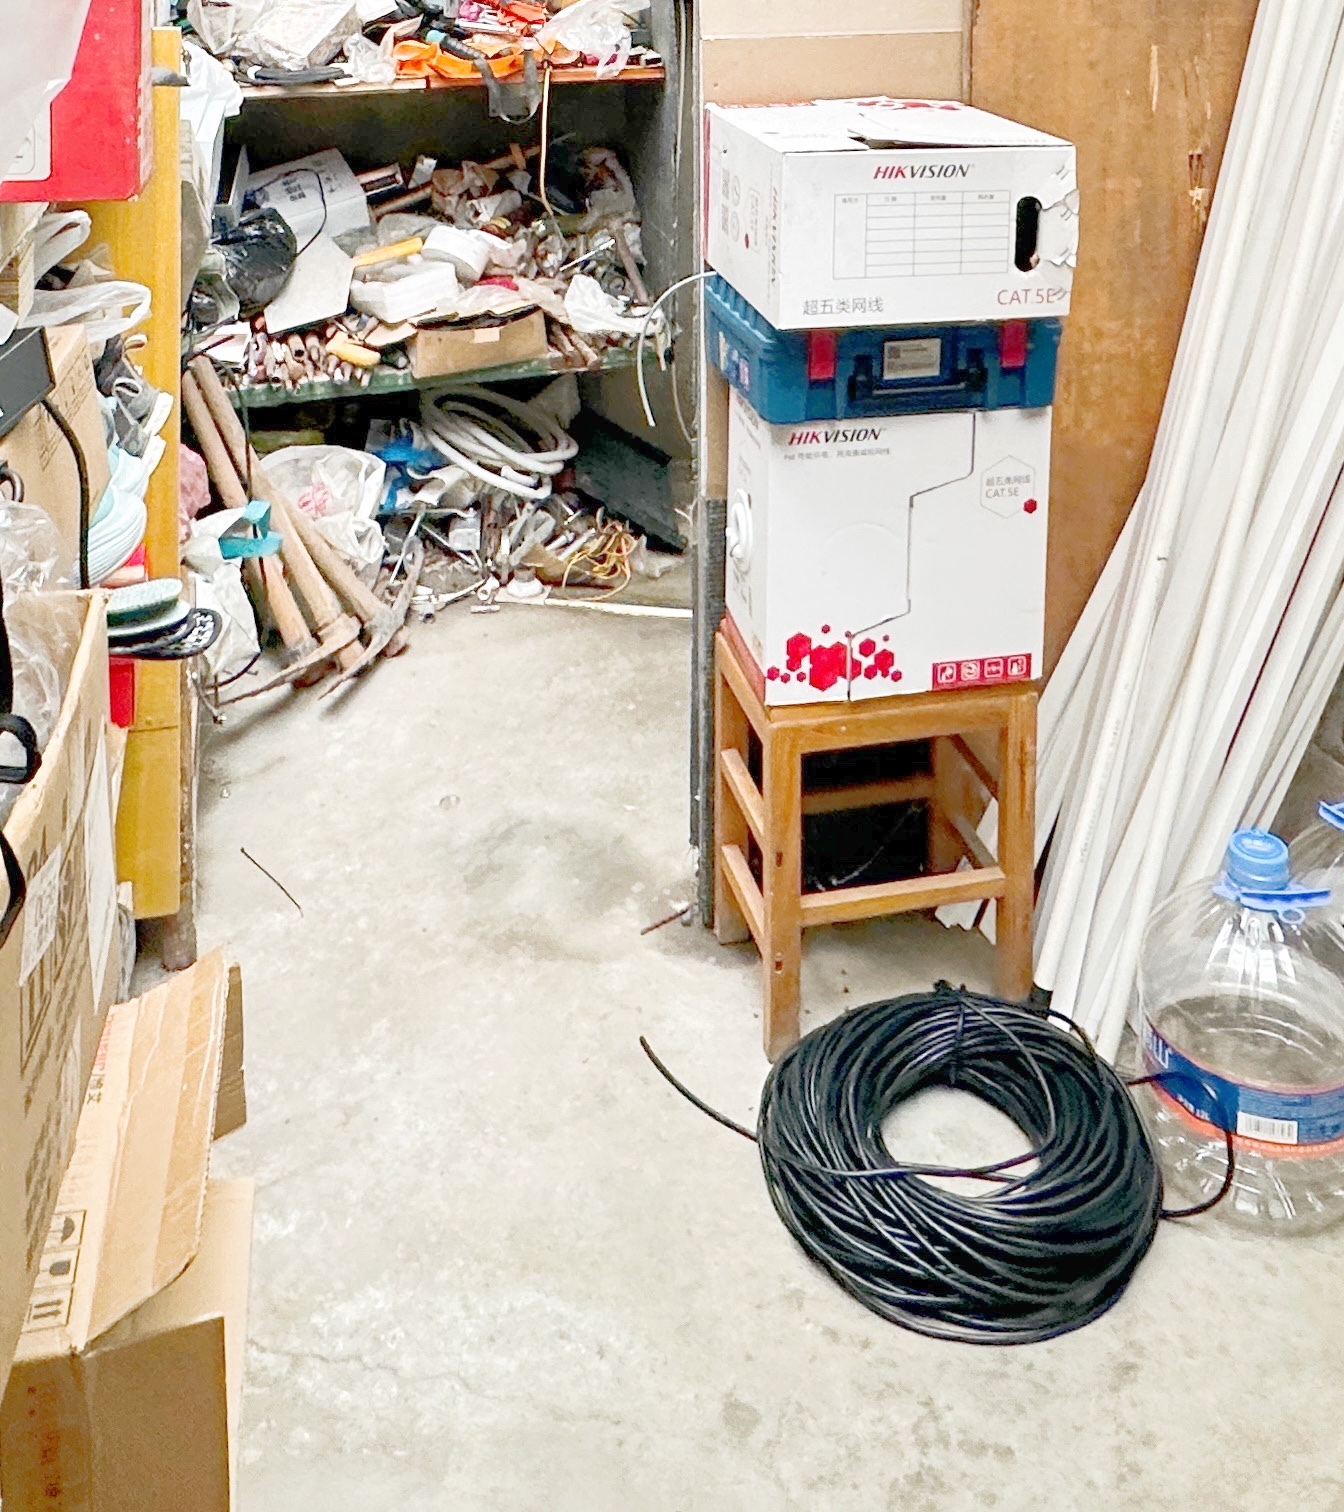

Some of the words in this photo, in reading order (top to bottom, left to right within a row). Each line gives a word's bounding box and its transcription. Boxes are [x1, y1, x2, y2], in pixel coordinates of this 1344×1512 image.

[872, 164, 970, 180] HIKVISION
[802, 296, 885, 316] 超五类网线
[788, 428, 883, 446] HIKVISION
